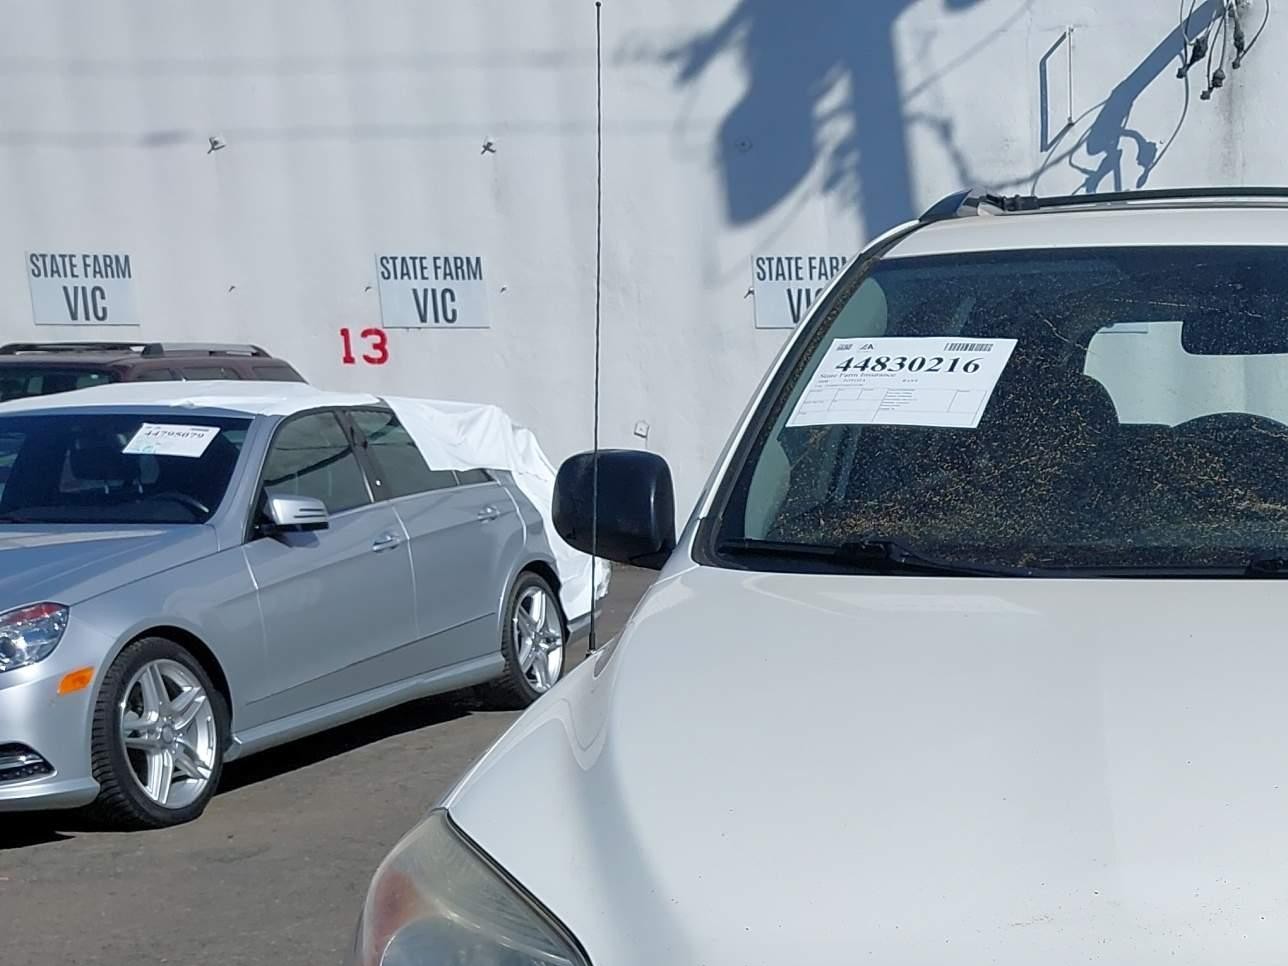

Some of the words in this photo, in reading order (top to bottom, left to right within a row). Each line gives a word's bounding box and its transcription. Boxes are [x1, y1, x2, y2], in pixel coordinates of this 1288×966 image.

[30, 253, 79, 278] STATE
[82, 254, 132, 279] FARM
[380, 256, 429, 280] STATE
[433, 256, 483, 281] FARM
[756, 256, 804, 281] STATE
[808, 256, 847, 280] FAR
[62, 285, 108, 322] VIC
[412, 287, 458, 324] VIC
[786, 288, 823, 324] VI
[340, 327, 389, 365] 13
[835, 356, 984, 374] 44830216
